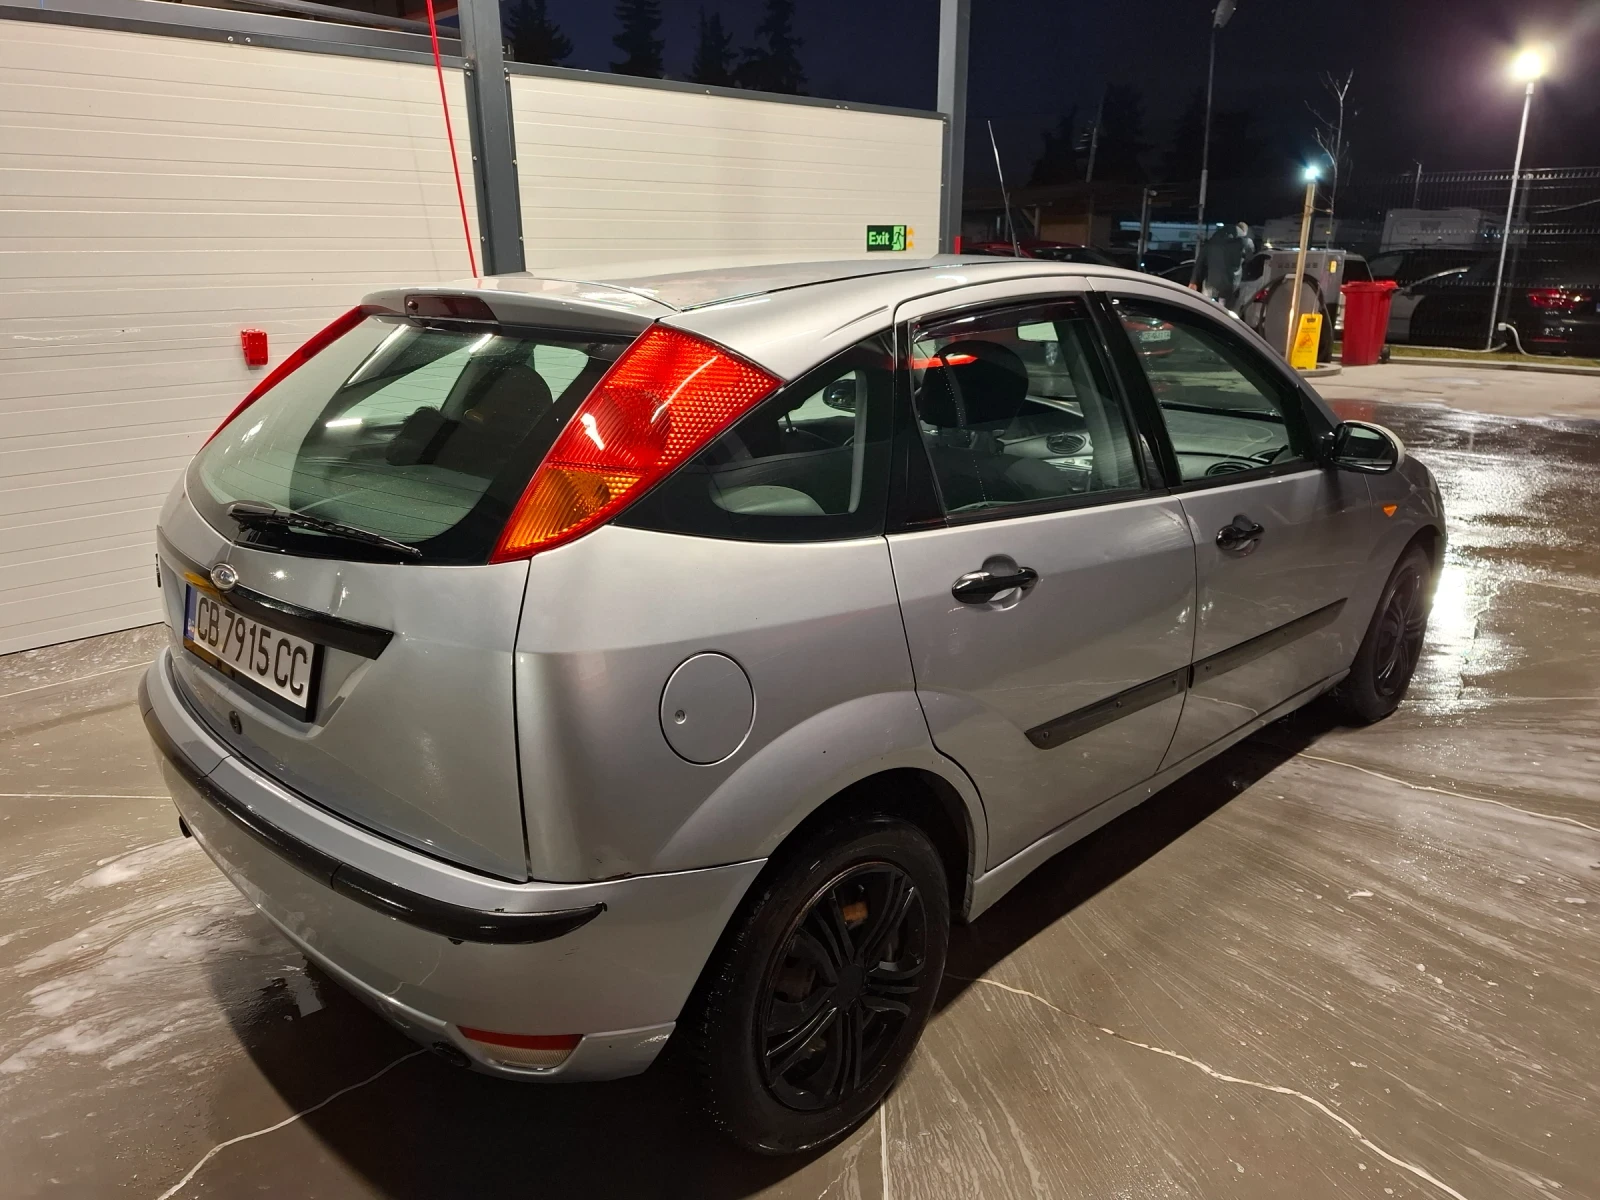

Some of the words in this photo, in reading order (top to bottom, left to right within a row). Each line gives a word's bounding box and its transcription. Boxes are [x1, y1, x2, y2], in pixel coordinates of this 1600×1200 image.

[868, 231, 890, 245] Exit
[198, 597, 220, 647] CB
[222, 609, 272, 676] 7915
[274, 638, 307, 696] CC
